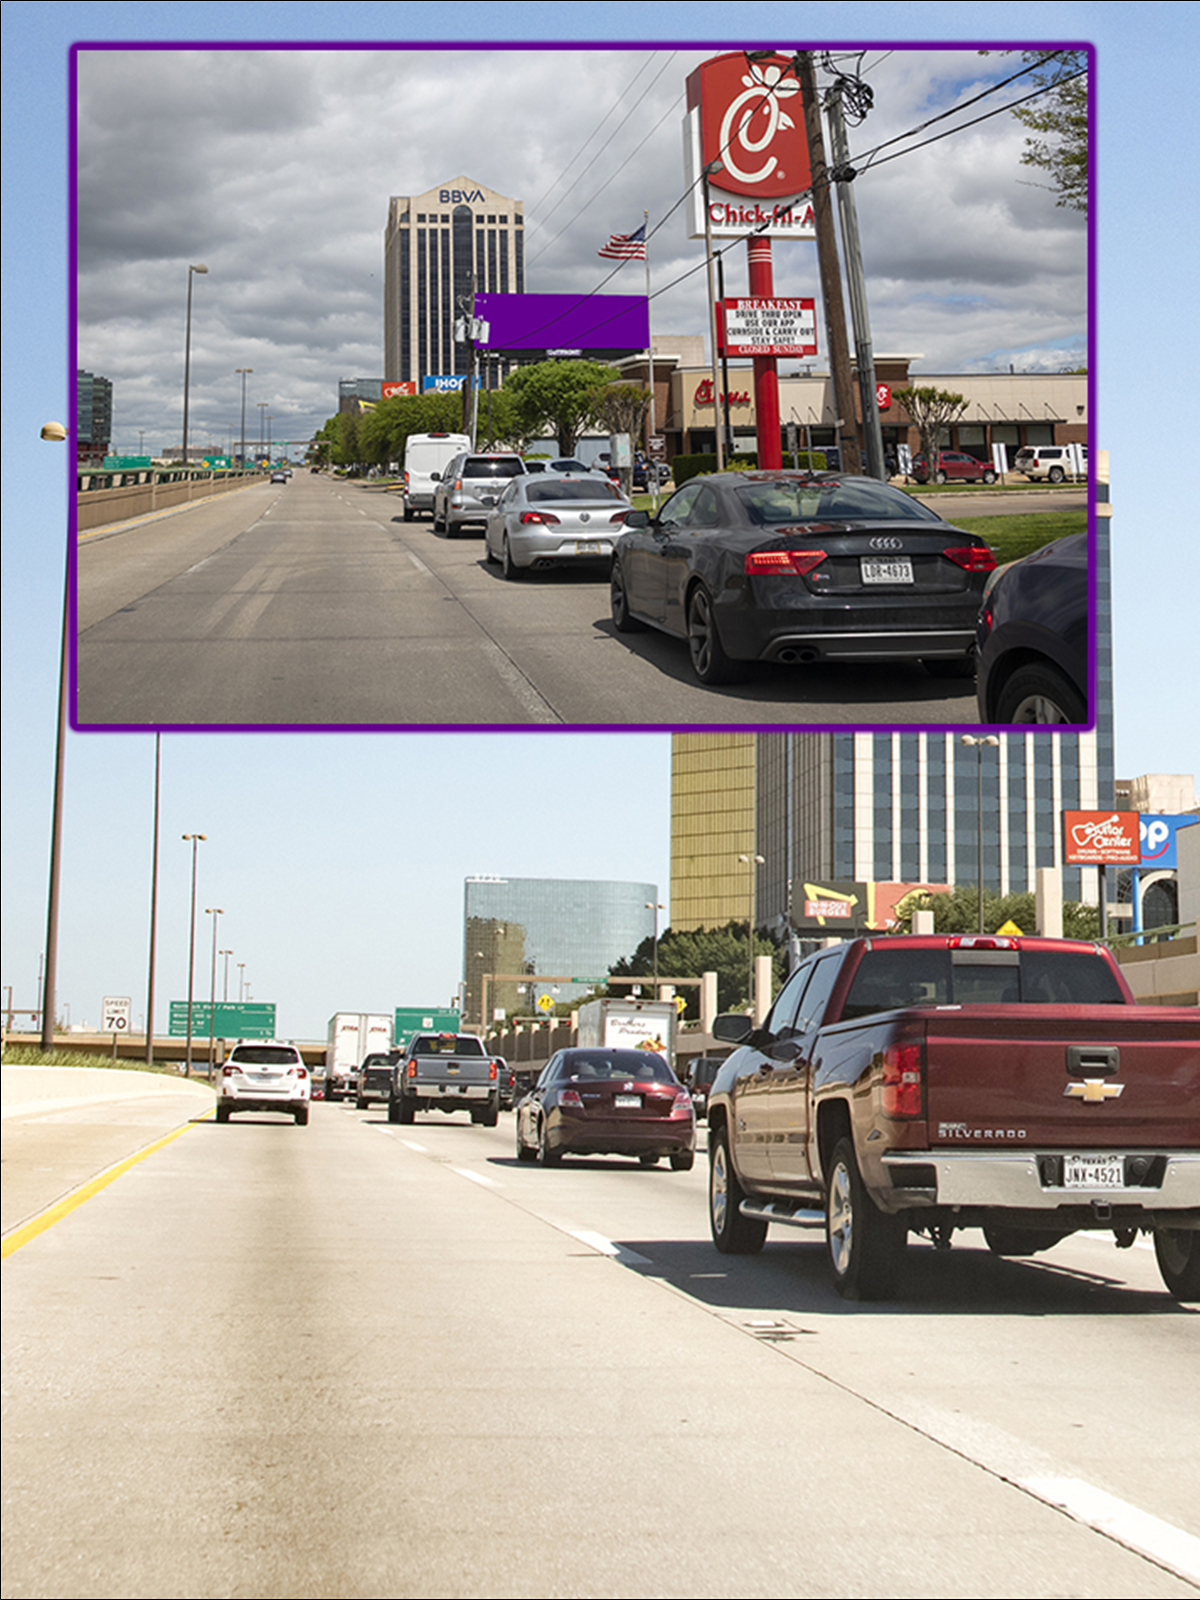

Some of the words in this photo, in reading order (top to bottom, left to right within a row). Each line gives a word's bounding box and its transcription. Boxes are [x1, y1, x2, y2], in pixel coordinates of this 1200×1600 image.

[439, 189, 485, 203] BBVA
[708, 202, 816, 225] Chick-fil-A
[737, 300, 803, 310] BREAKFAST
[735, 310, 758, 319] DRIVE
[761, 310, 781, 319] THRU
[783, 310, 802, 319] OPEN
[745, 319, 759, 327] USE
[761, 319, 778, 327] OUR
[780, 319, 795, 327] APP
[727, 328, 764, 336] CURBSIDE
[772, 328, 798, 336] CARRY
[799, 328, 815, 336] OUT
[751, 337, 770, 345] STAY
[738, 345, 770, 354] CLOSED
[773, 345, 804, 355] SUNDAY
[1093, 834, 1132, 849] Center
[808, 901, 848, 910] IN-N-OUT
[808, 909, 848, 917] BURGER
[106, 1017, 127, 1030] 70
[938, 1129, 1027, 1139] SILVERADO
[1065, 1167, 1122, 1183] JNX-4521
